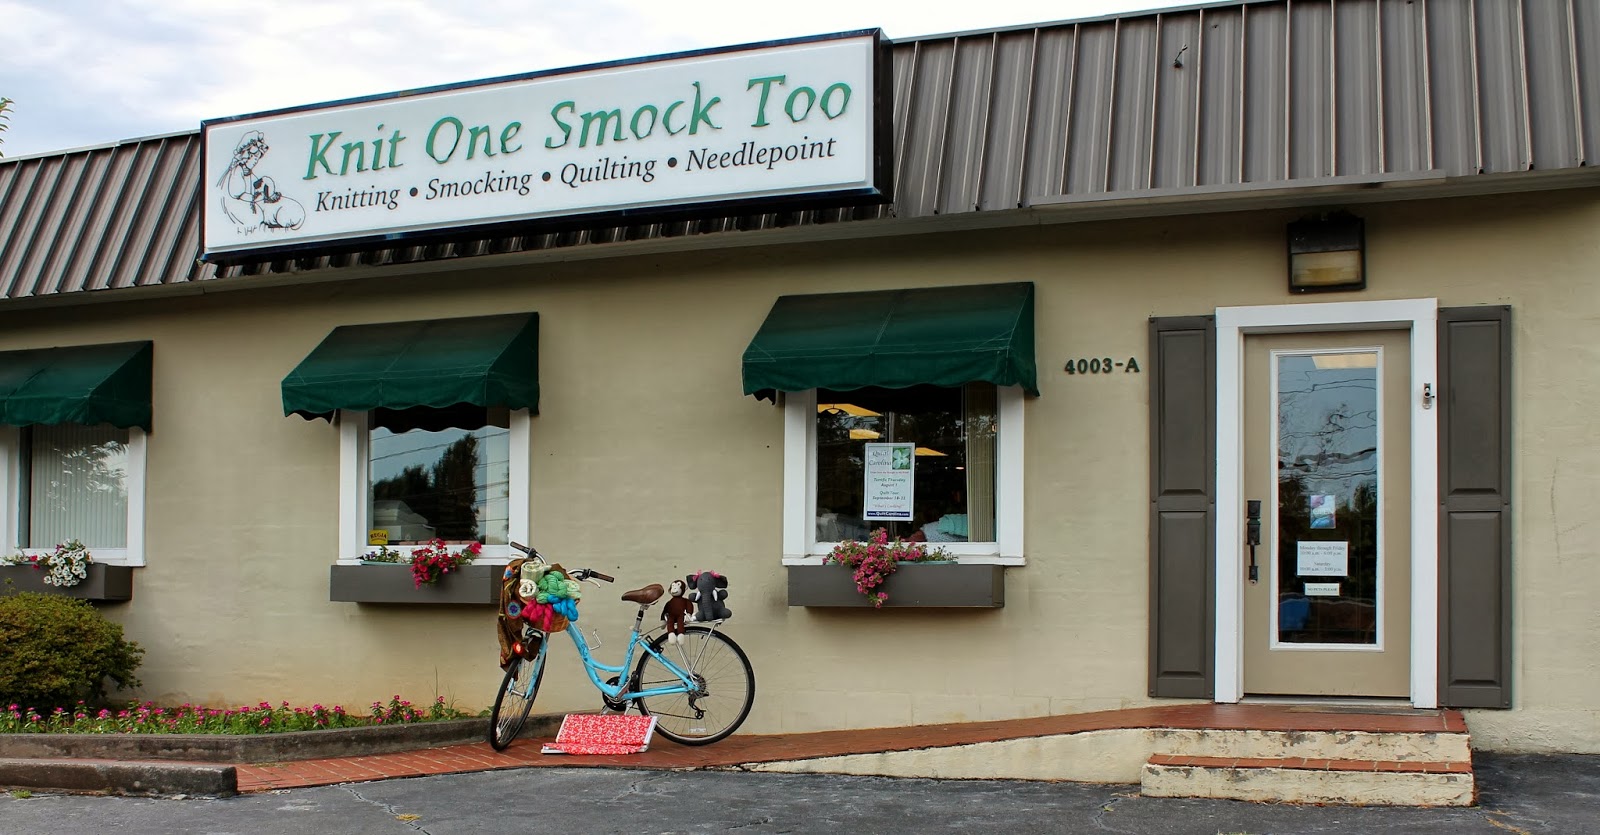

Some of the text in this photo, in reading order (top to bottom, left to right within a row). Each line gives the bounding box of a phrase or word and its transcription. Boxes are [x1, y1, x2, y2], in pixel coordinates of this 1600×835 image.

[302, 74, 852, 181] Knit One Smock Too
[315, 137, 837, 213] Knitting Smocking Quilting Needlepoint
[1064, 356, 1140, 375] 4003-A
